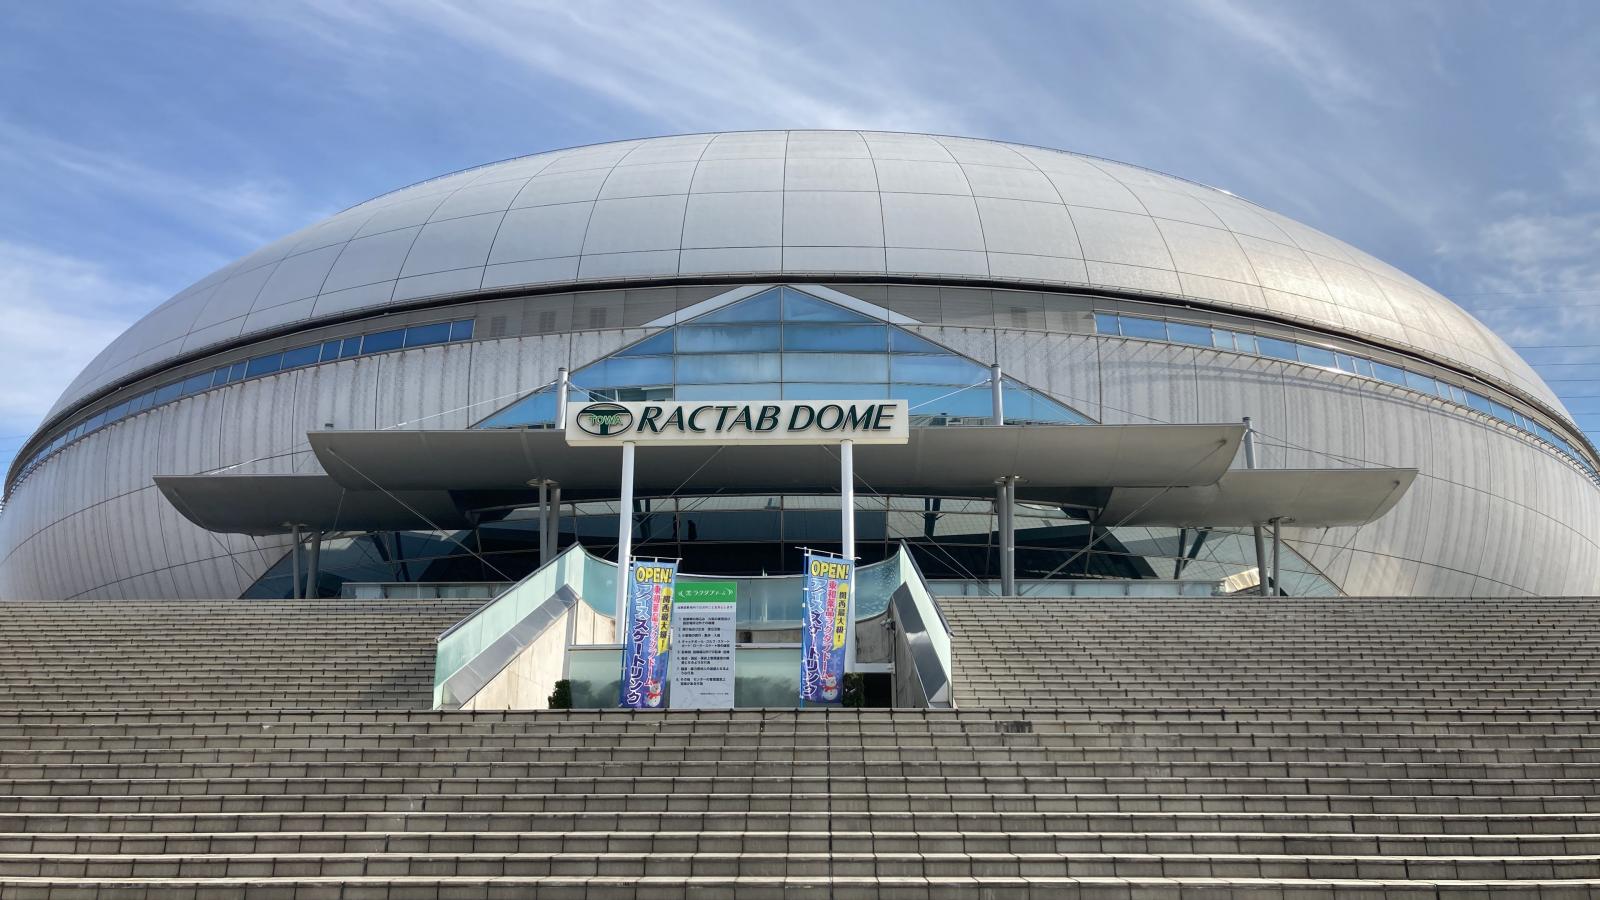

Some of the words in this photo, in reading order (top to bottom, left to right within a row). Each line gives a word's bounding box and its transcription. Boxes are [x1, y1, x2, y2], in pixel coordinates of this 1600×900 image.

[591, 414, 621, 425] TOWA
[636, 404, 780, 433] RACTAB
[787, 404, 897, 432] DOME
[636, 566, 673, 583] OPEN!
[811, 560, 850, 580] OPEN!
[627, 584, 652, 704] アイススケートリンク
